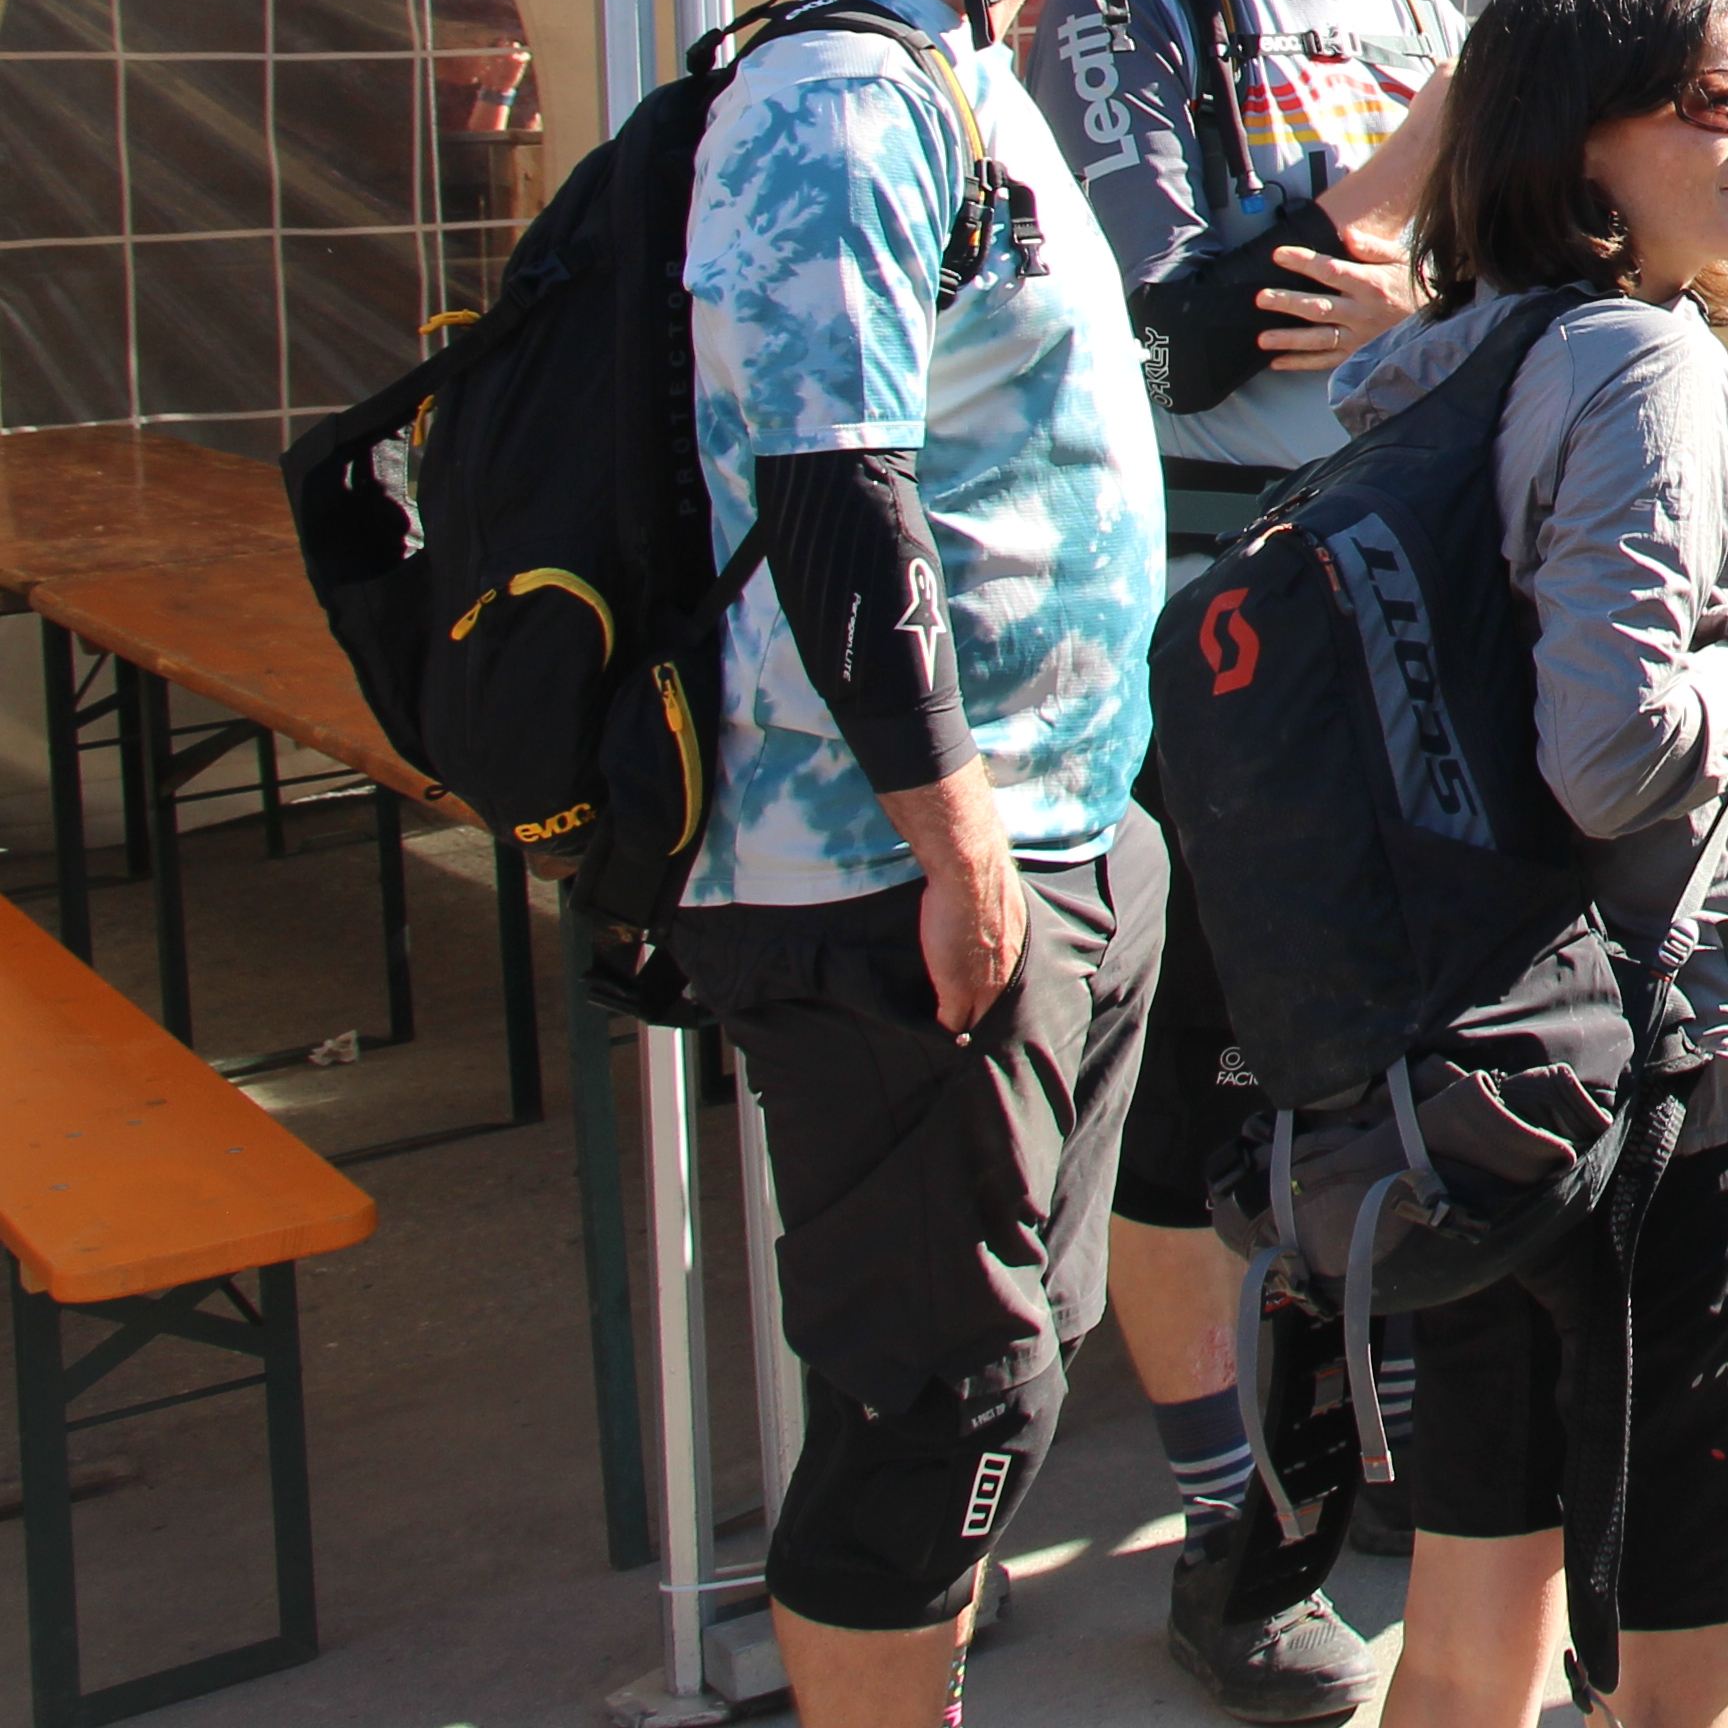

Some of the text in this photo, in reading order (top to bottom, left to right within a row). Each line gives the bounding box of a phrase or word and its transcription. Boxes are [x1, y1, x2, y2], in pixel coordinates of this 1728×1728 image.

[1057, 12, 1141, 182] Leatt
[665, 260, 696, 516] PROTECTOR
[1144, 326, 1174, 408] OAKLEY
[1350, 536, 1479, 817] SCOTT
